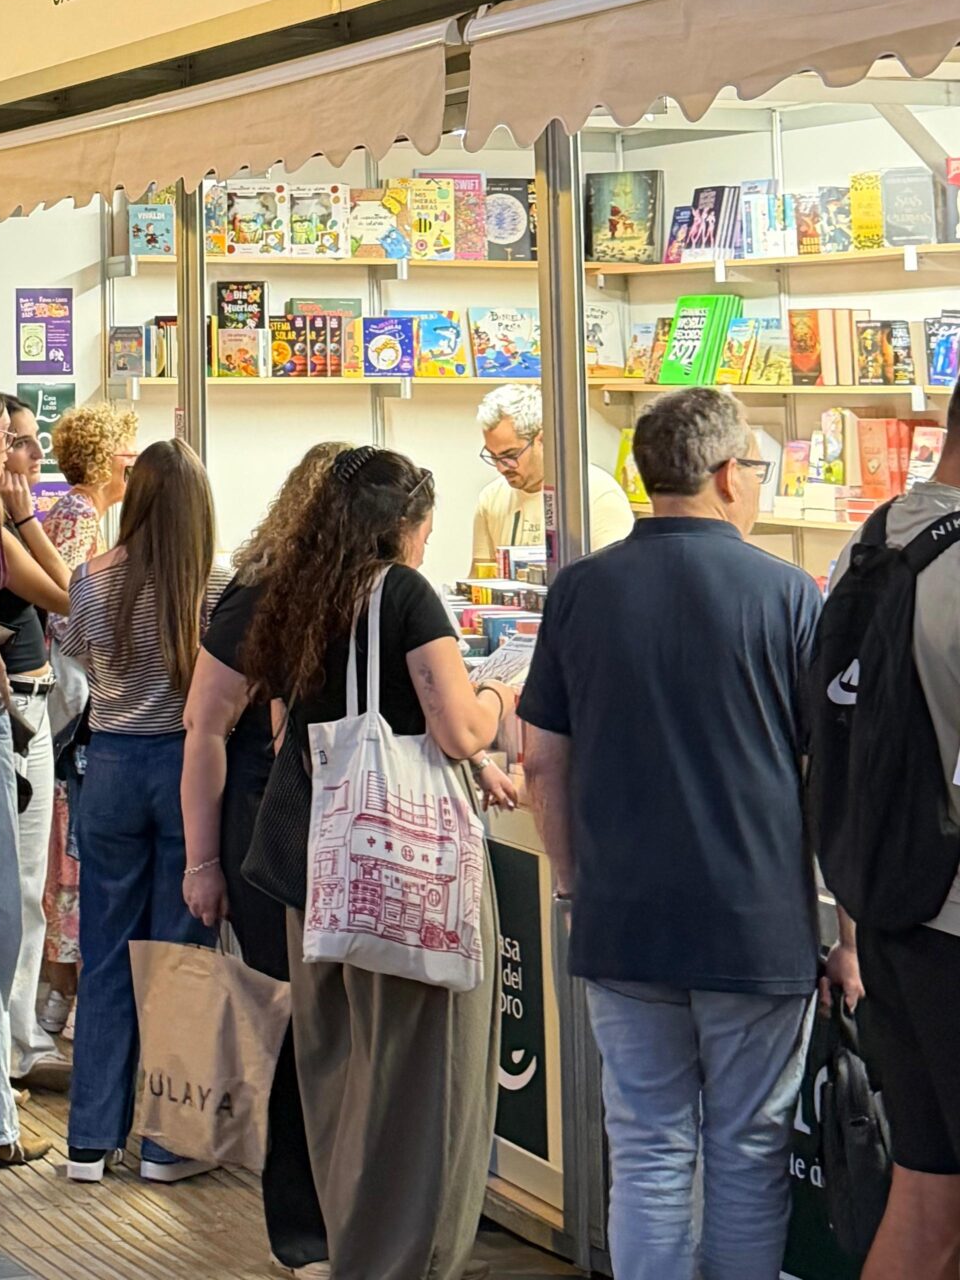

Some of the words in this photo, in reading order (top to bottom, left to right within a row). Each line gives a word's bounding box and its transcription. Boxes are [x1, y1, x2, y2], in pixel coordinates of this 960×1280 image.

[455, 179, 479, 191] SWIFT
[269, 322, 291, 331] STEMA
[275, 330, 297, 340] SOLAR
[931, 519, 960, 541] NIK
[498, 934, 521, 962] asa
[503, 962, 522, 991] del
[143, 1071, 235, 1119] ULAYA
